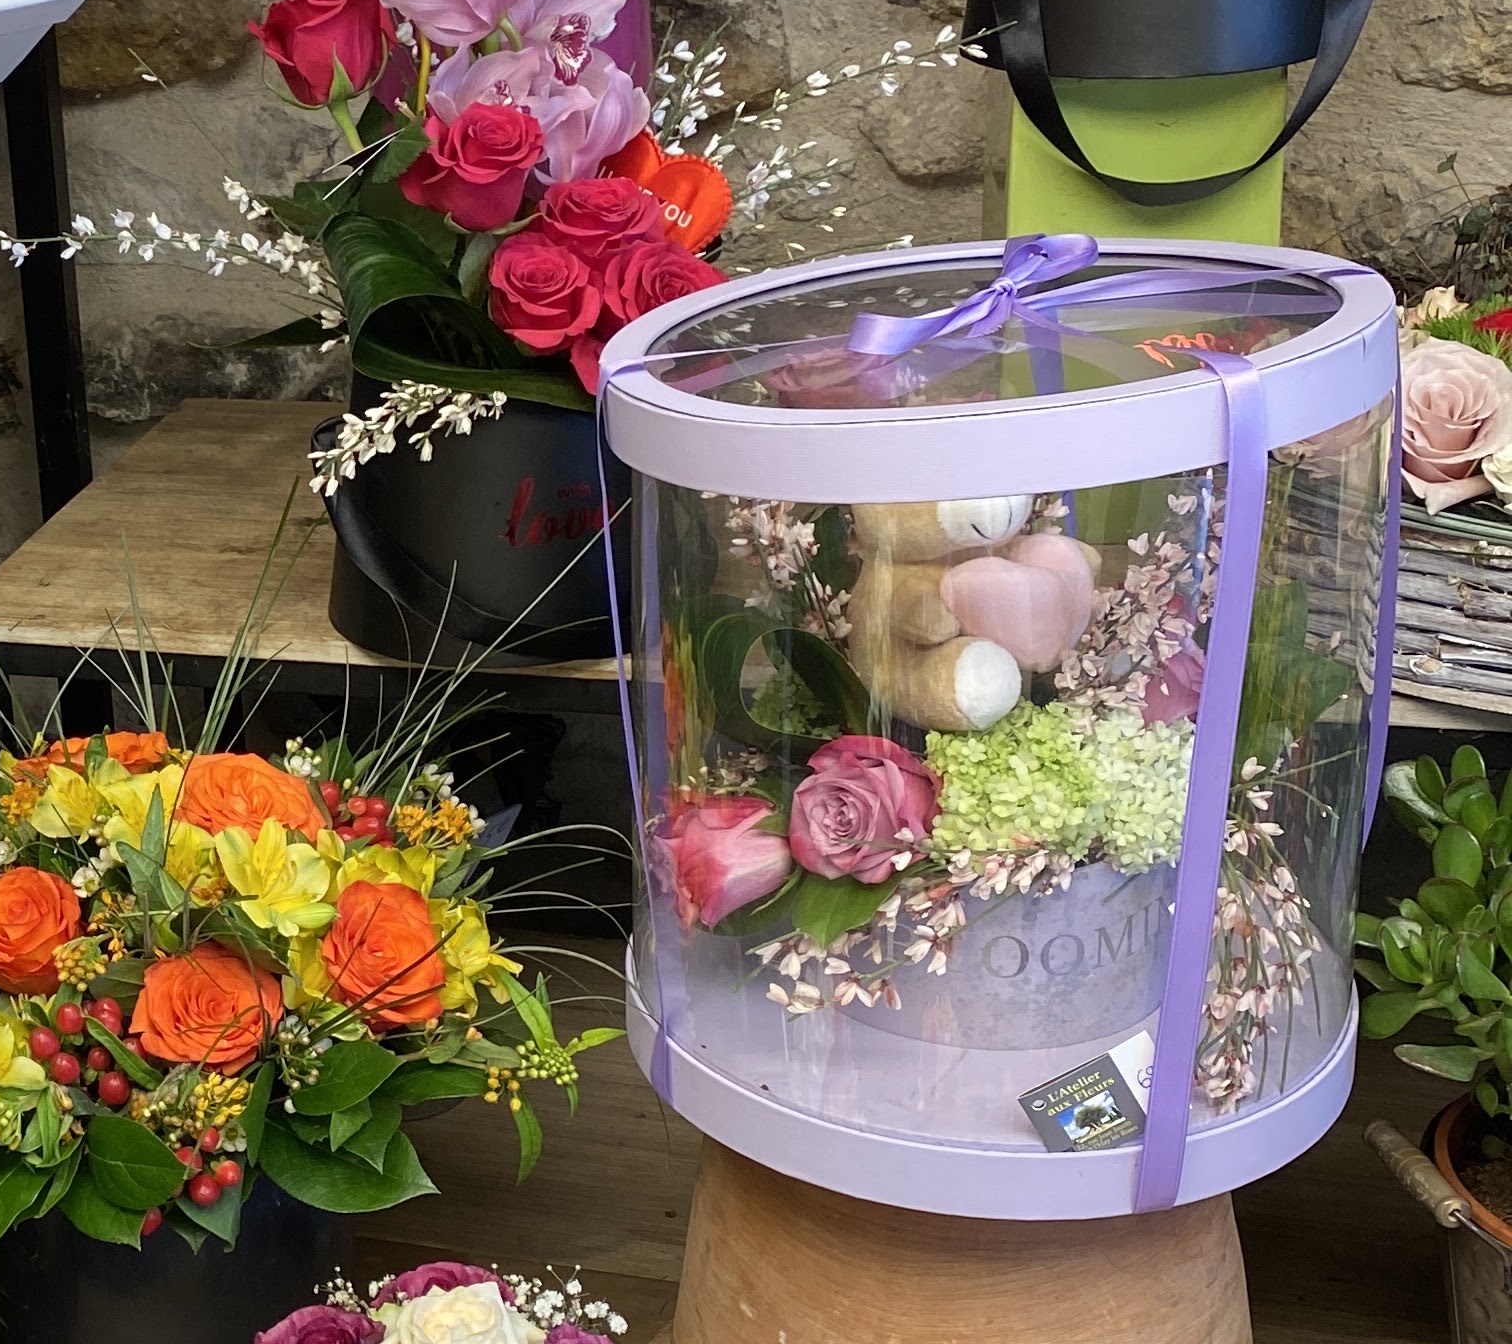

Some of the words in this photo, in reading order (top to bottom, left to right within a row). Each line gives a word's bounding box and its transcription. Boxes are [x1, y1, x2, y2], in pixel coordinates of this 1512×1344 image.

[1047, 1071, 1101, 1103] L'Atelier
[1047, 1100, 1072, 1117] aux
[1073, 1077, 1116, 1102] Fleurs
